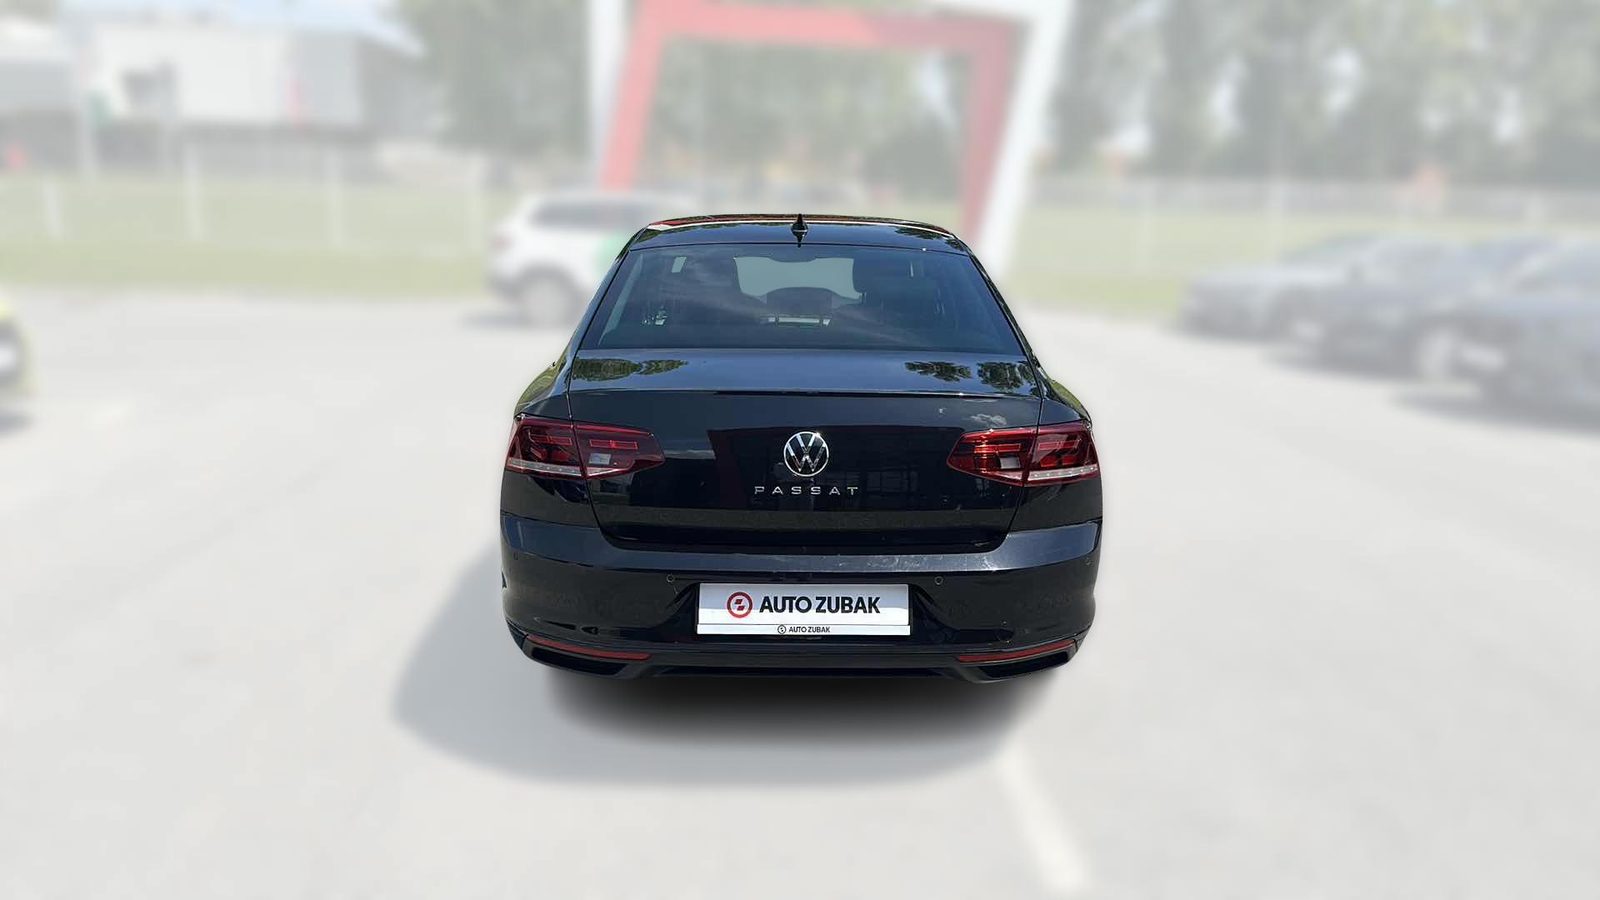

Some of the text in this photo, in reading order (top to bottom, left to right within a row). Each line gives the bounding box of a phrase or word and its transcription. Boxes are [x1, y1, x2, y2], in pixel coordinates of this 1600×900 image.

[754, 486, 858, 495] PASSAT
[759, 596, 880, 614] AUTO ZUBAK
